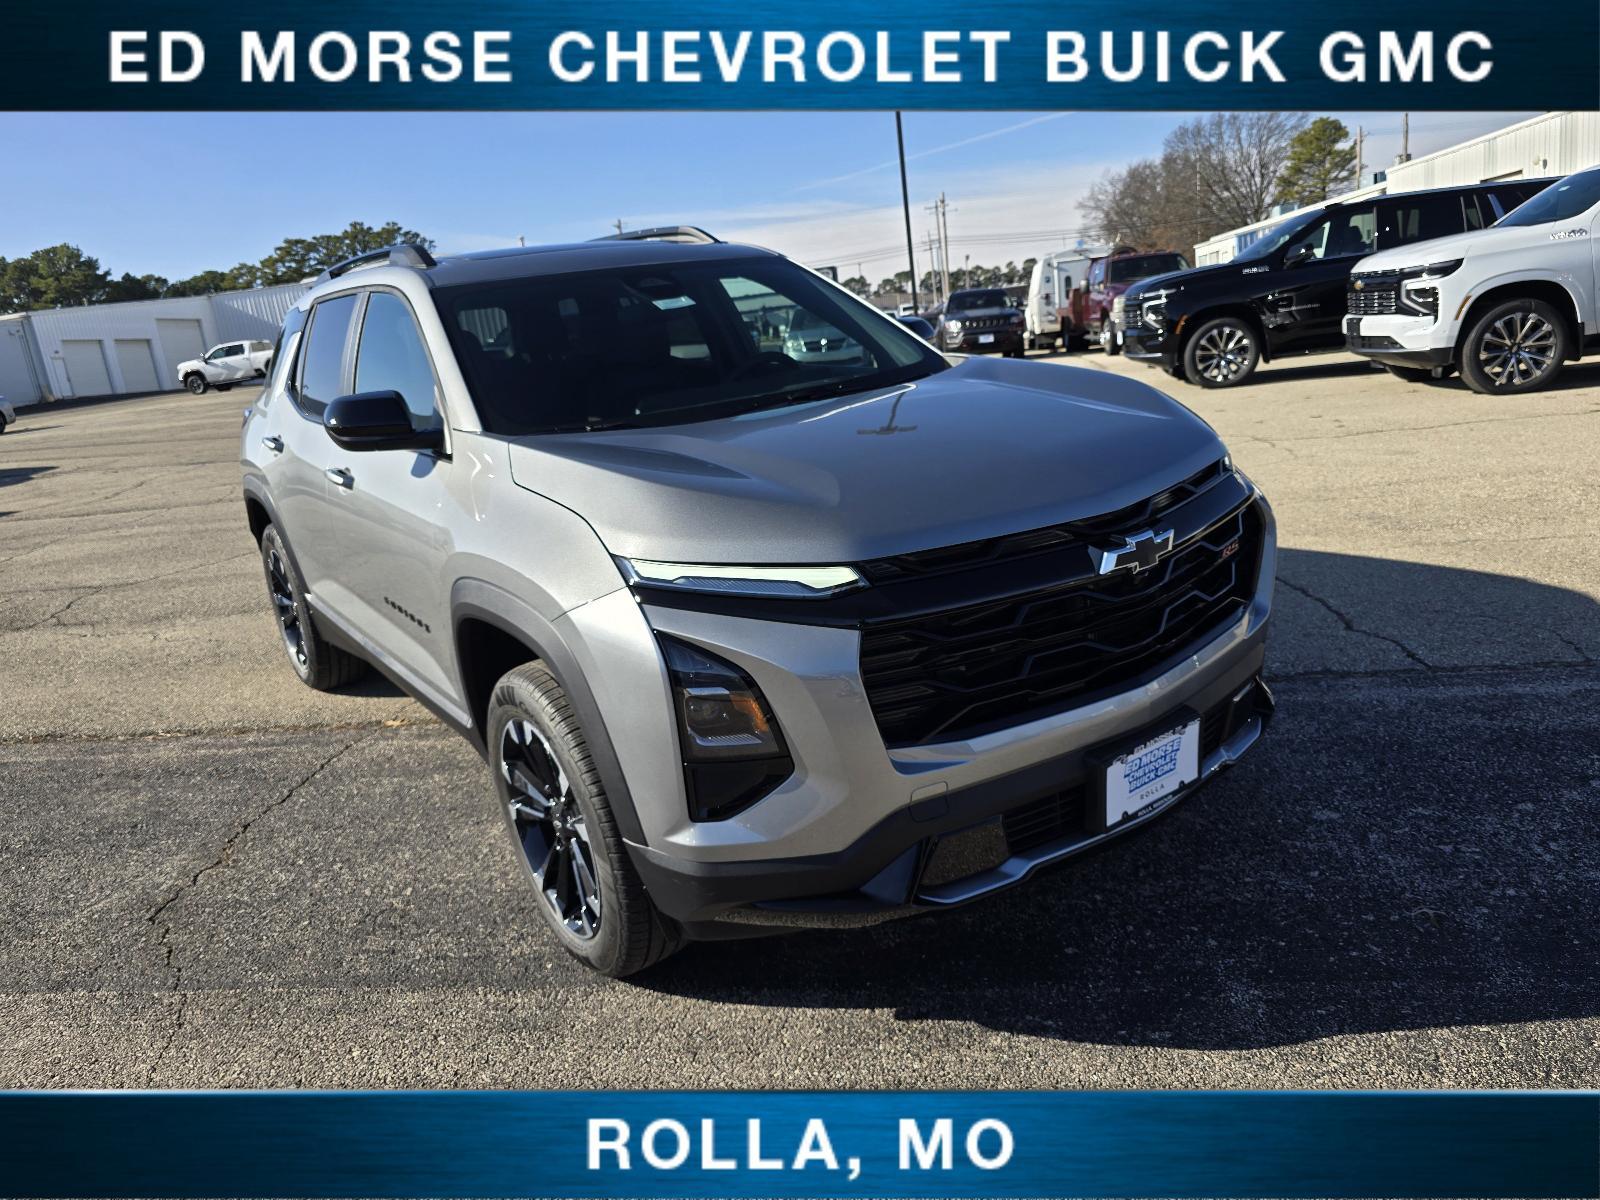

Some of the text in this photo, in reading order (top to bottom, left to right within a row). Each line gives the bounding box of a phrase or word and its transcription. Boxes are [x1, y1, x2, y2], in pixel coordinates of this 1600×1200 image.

[1124, 737, 1181, 777] ED MORSE
[1129, 752, 1177, 784] CHEVROLET
[1140, 783, 1165, 800] ROLLA
